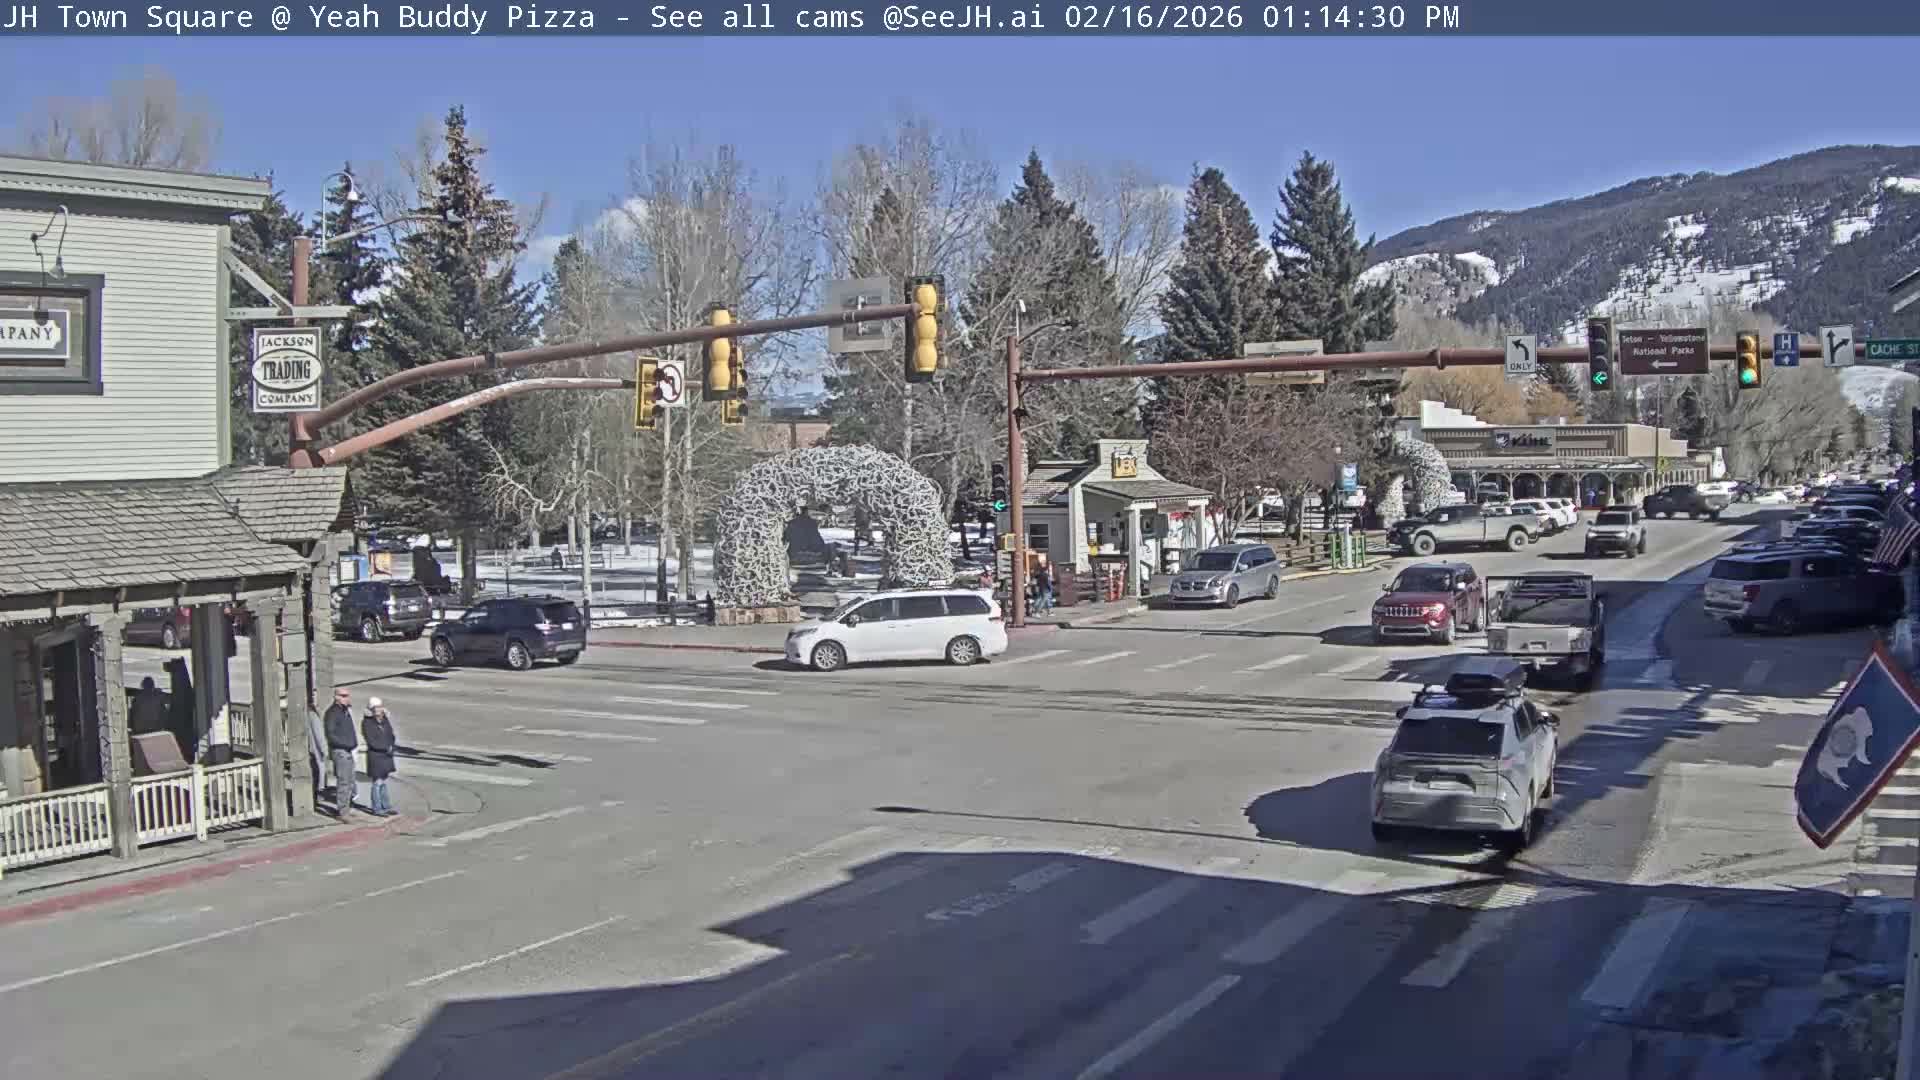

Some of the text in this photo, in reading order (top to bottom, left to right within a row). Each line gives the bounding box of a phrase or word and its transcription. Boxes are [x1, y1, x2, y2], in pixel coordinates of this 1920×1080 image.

[261, 336, 314, 347] JACKSON
[1781, 334, 1792, 349] H
[1671, 346, 1695, 355] Parks
[1871, 343, 1904, 356] CACHE
[261, 360, 311, 380] TRADING
[1510, 362, 1533, 371] ONLY
[260, 393, 313, 404] COMPANY
